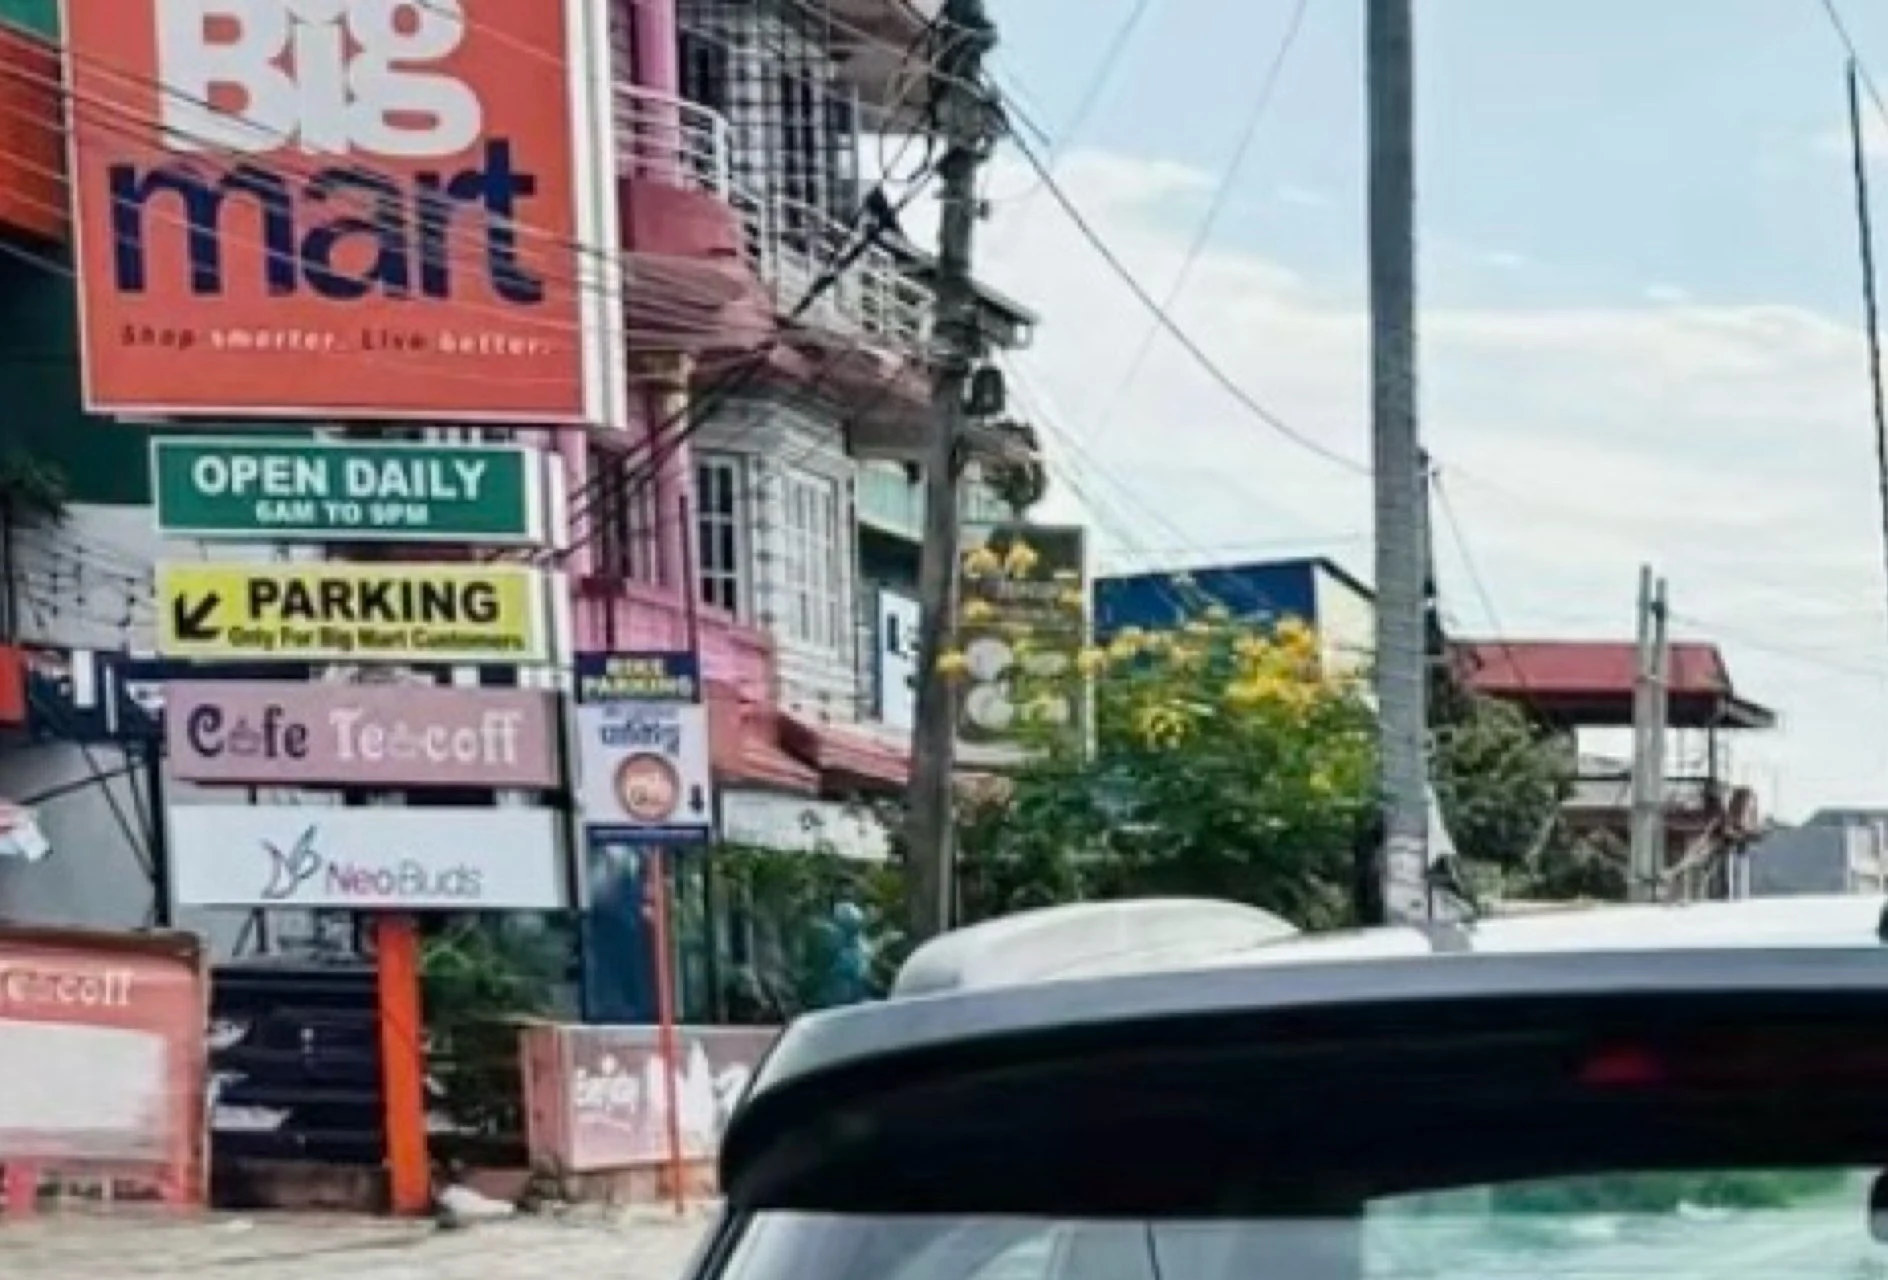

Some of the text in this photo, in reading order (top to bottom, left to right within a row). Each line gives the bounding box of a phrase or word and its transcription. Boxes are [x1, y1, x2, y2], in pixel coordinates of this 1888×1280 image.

[153, 0, 482, 155] Big
[108, 140, 543, 301] mart
[192, 454, 486, 501] OPEN DAILY
[323, 502, 362, 523] TO
[248, 577, 499, 622] PARKING
[228, 626, 274, 651] Only
[320, 627, 354, 652] Big
